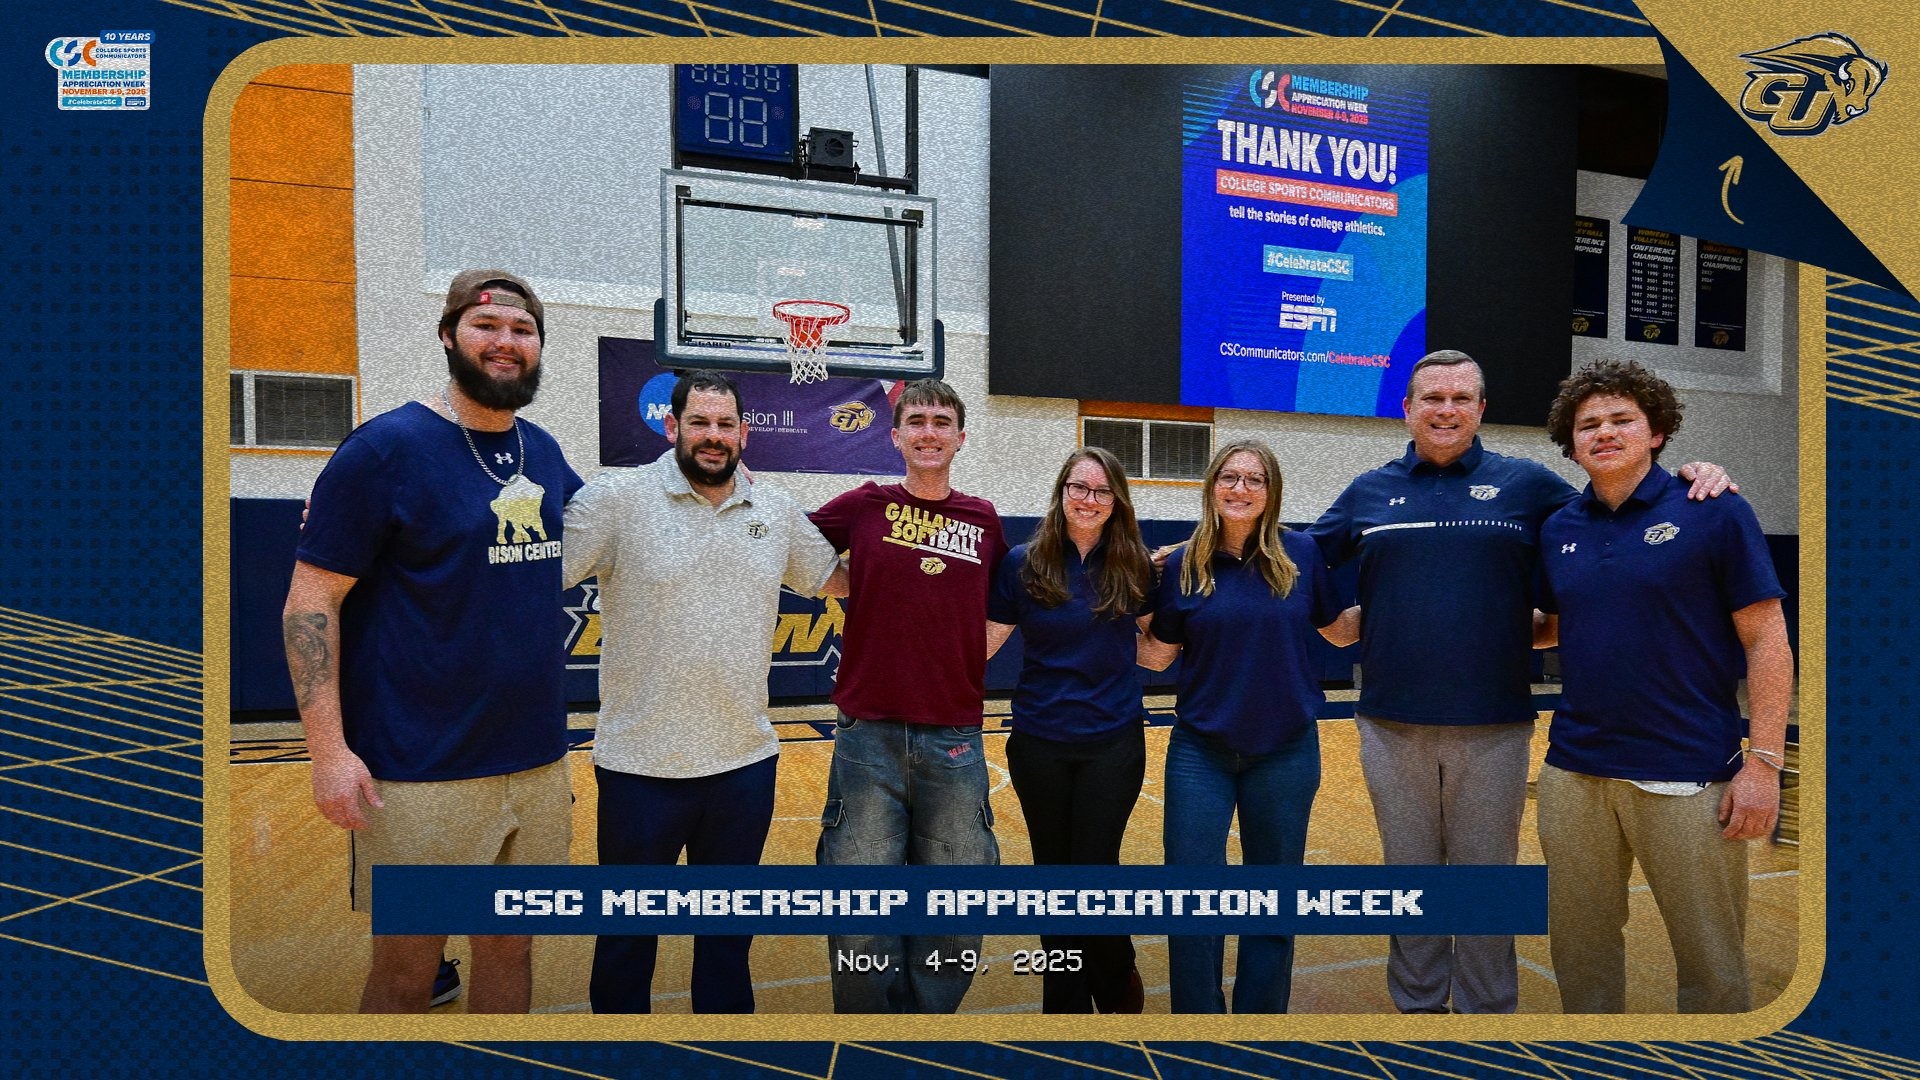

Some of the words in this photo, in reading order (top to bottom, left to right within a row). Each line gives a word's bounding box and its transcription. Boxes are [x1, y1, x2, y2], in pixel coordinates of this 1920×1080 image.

[1291, 74, 1369, 101] MEMBERSHIP
[1291, 92, 1345, 110] APPRECIATION
[1347, 102, 1368, 113] WEEK
[1291, 104, 1334, 120] NOVEMBER
[1217, 119, 1322, 174] THANK
[1327, 135, 1397, 185] YOU!
[1220, 176, 1266, 194] COLLEGE
[1268, 180, 1307, 199] SPORTS
[1309, 187, 1394, 211] COMMUNICATORS
[1229, 205, 1245, 218] tell
[1247, 207, 1263, 221] the
[1265, 209, 1297, 225] stories
[1298, 213, 1309, 226] of
[1310, 216, 1343, 233] college
[1344, 219, 1386, 236] athletics.
[1630, 243, 1677, 256] CONFERENCE
[1632, 252, 1674, 263] CHAMPIONS
[1700, 252, 1745, 264] CONFERENCE
[1267, 251, 1350, 275] #CelebrateCSC
[1702, 261, 1743, 272] CHAMPIONS
[1281, 291, 1316, 303] Presented
[1316, 295, 1325, 306] by
[1279, 303, 1337, 332] ESPN
[1219, 342, 1391, 368] CSCommunicators.com/CelebrateCSC
[885, 502, 984, 543] GALLAUDET
[891, 521, 978, 557] SOFTBALL
[488, 545, 523, 565] BISON
[525, 541, 562, 561] CENTER
